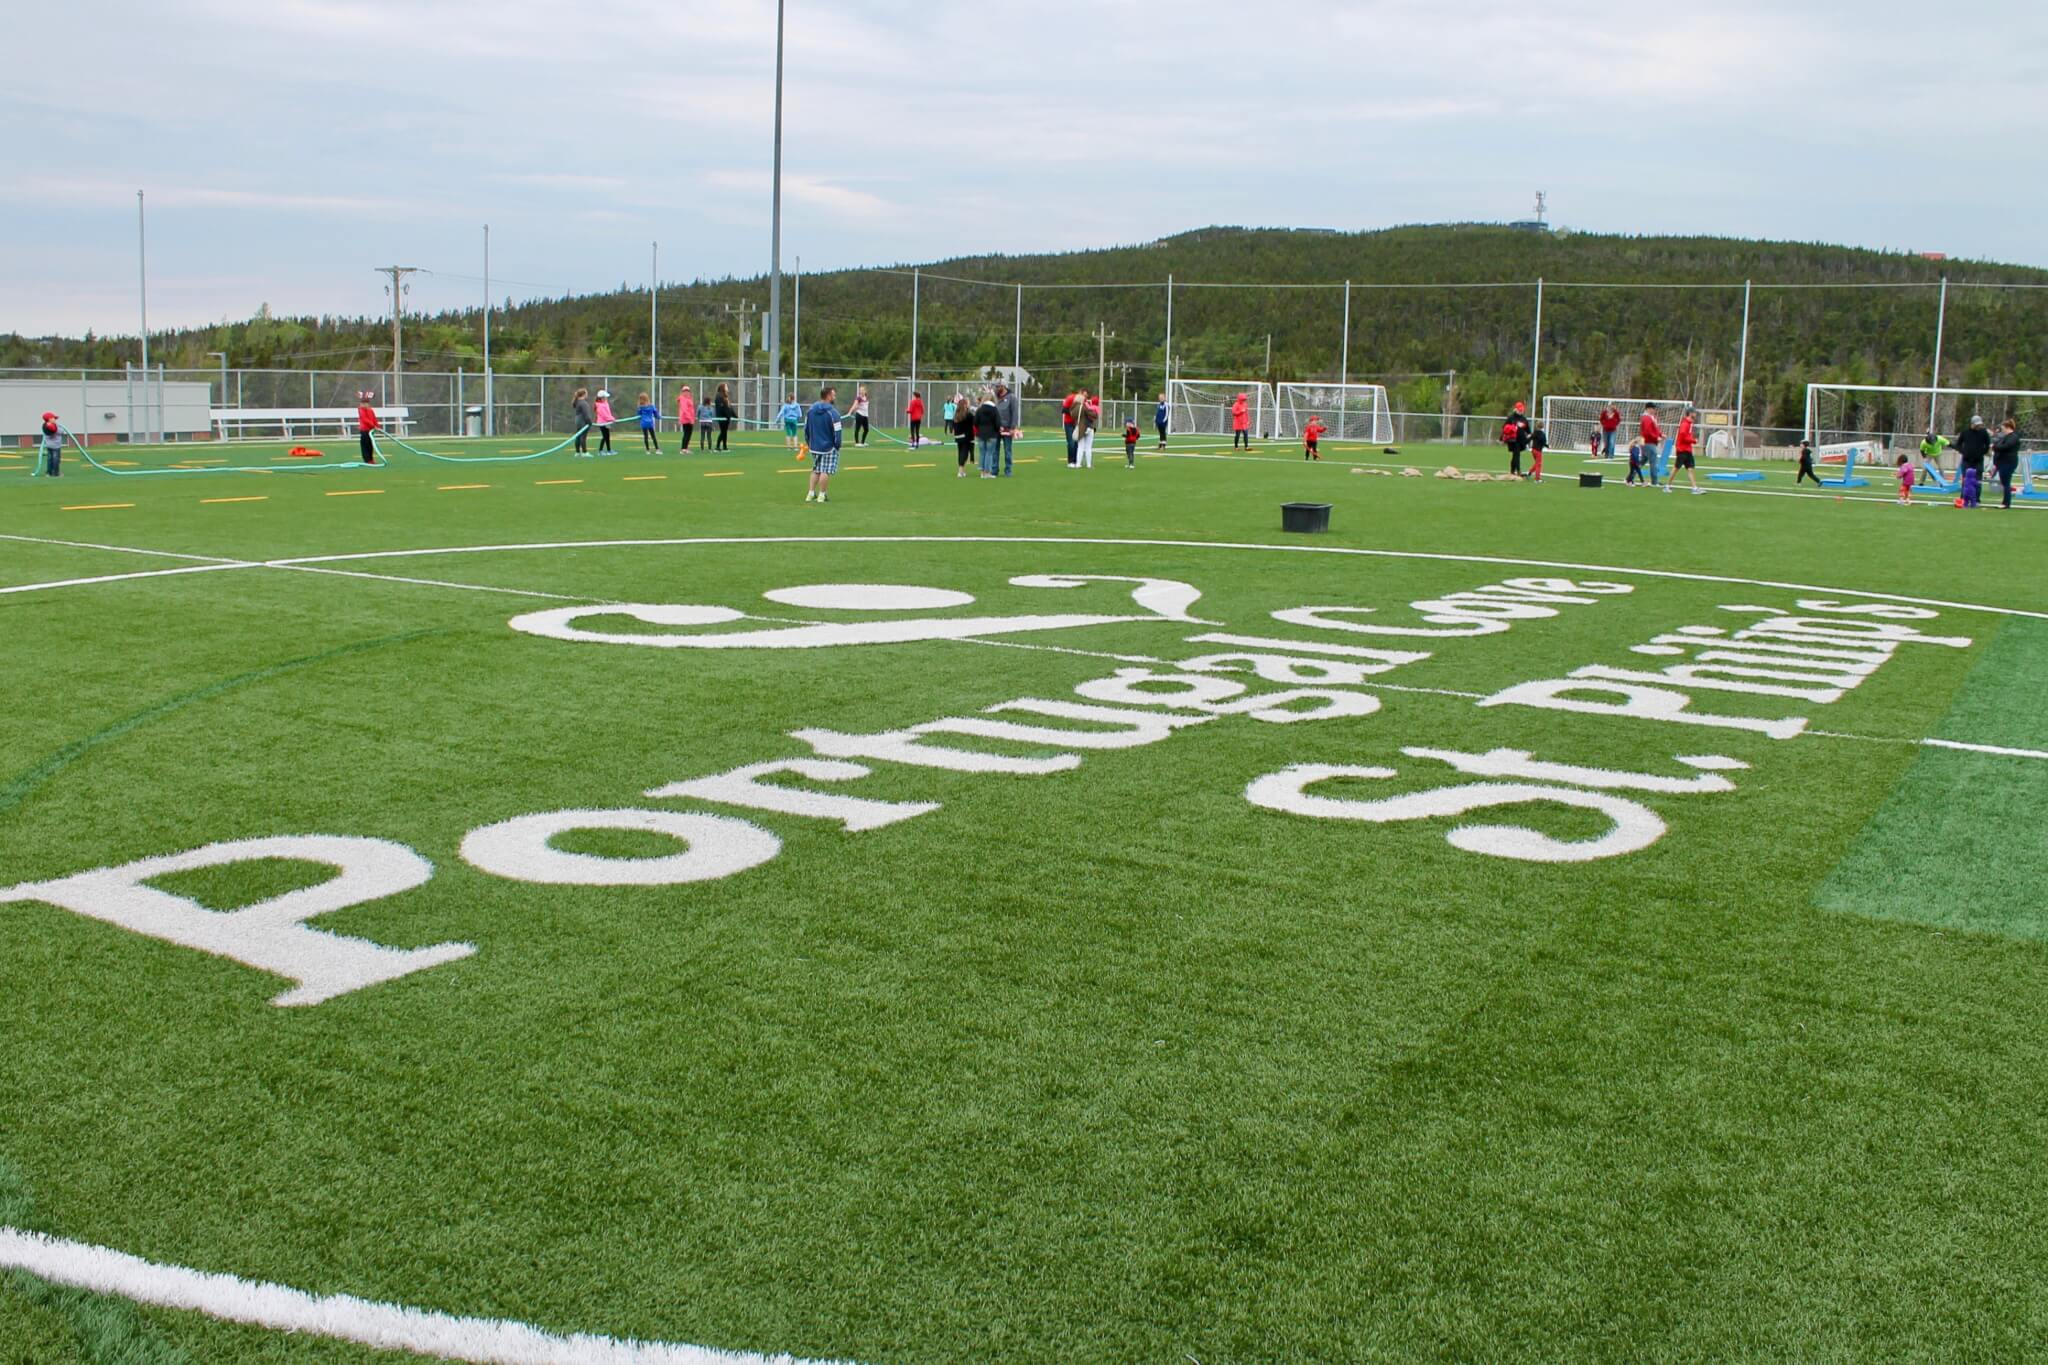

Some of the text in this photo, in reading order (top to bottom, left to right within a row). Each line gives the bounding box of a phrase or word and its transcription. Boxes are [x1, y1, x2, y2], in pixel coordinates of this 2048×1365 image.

[0, 577, 1634, 1006] Portugal Cove
[1244, 600, 1971, 861] St. Philip's
